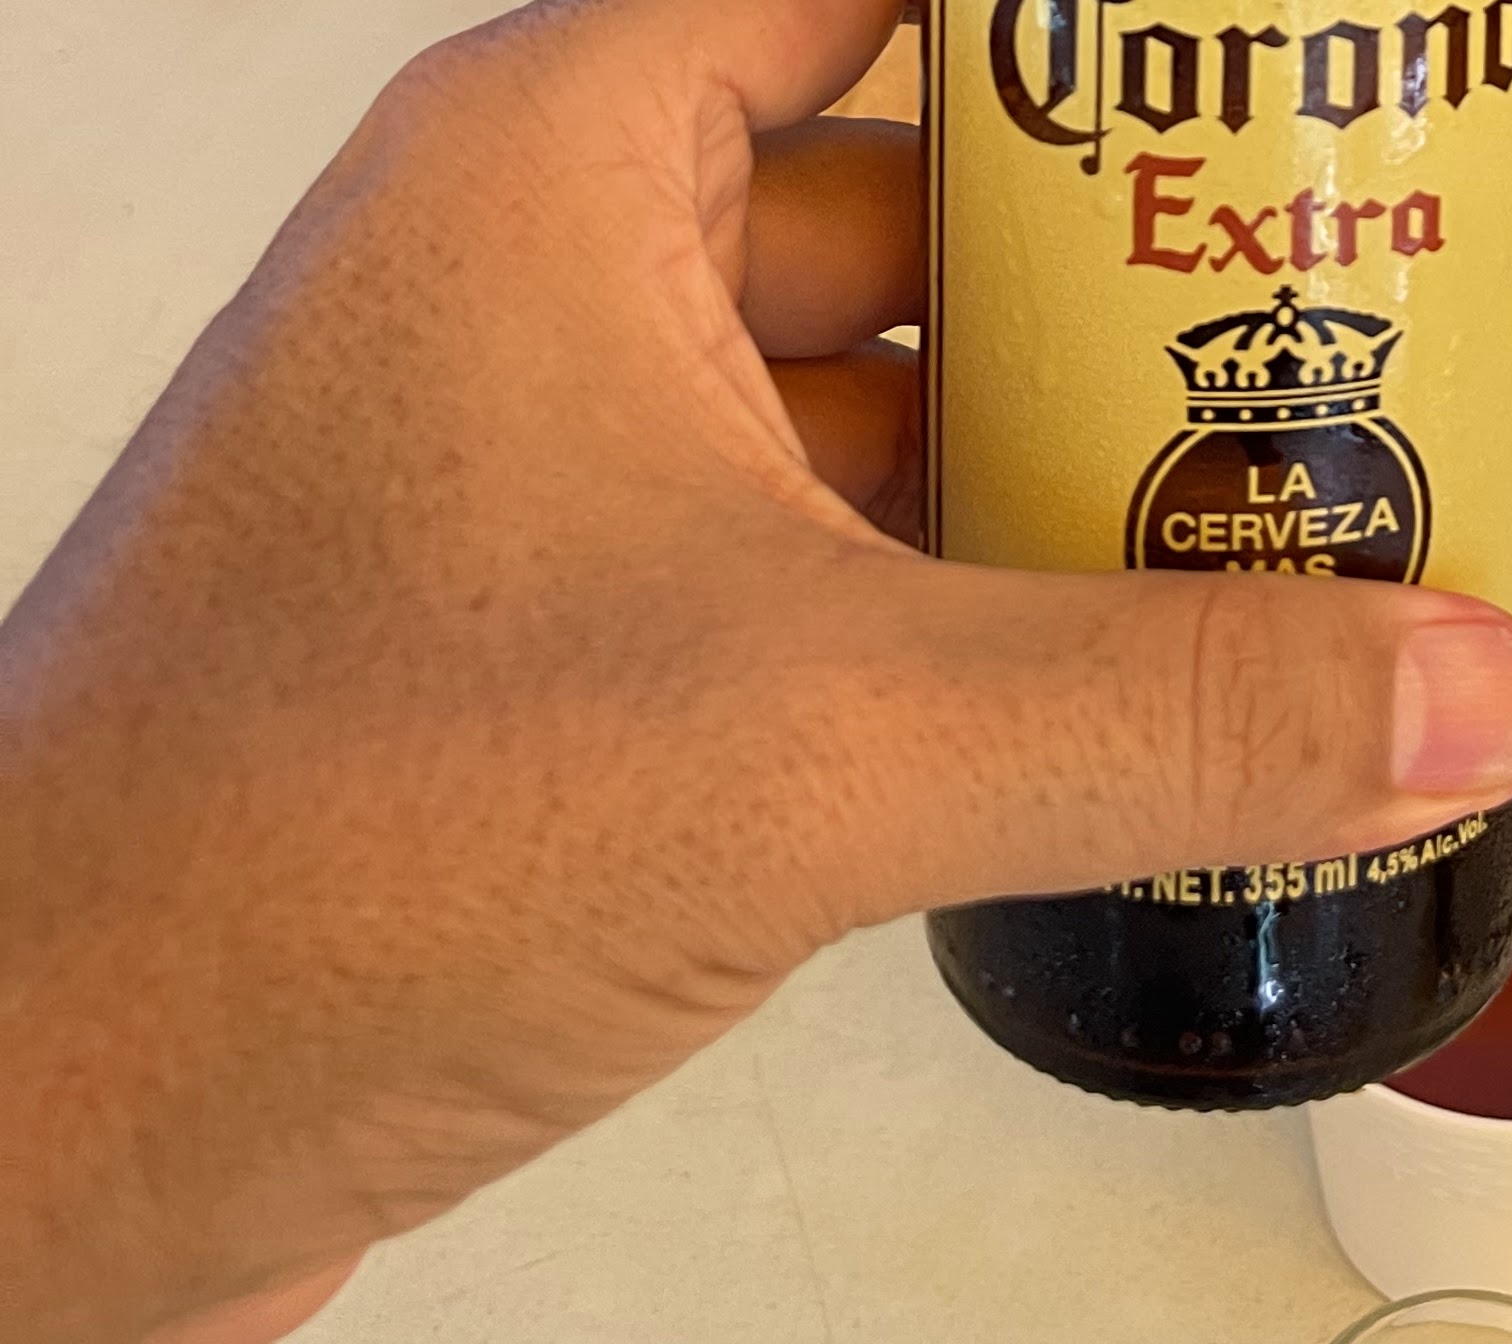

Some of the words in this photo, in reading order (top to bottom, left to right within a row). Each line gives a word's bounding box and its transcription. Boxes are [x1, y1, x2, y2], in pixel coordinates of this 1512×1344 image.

[1125, 152, 1446, 275] Extra
[1247, 462, 1317, 503] LA
[1161, 497, 1400, 552] CERVEZA
[1152, 865, 1236, 904] NET.
[1243, 861, 1307, 904] 355
[1313, 852, 1358, 895] ml
[1366, 845, 1419, 885] 4,5%
